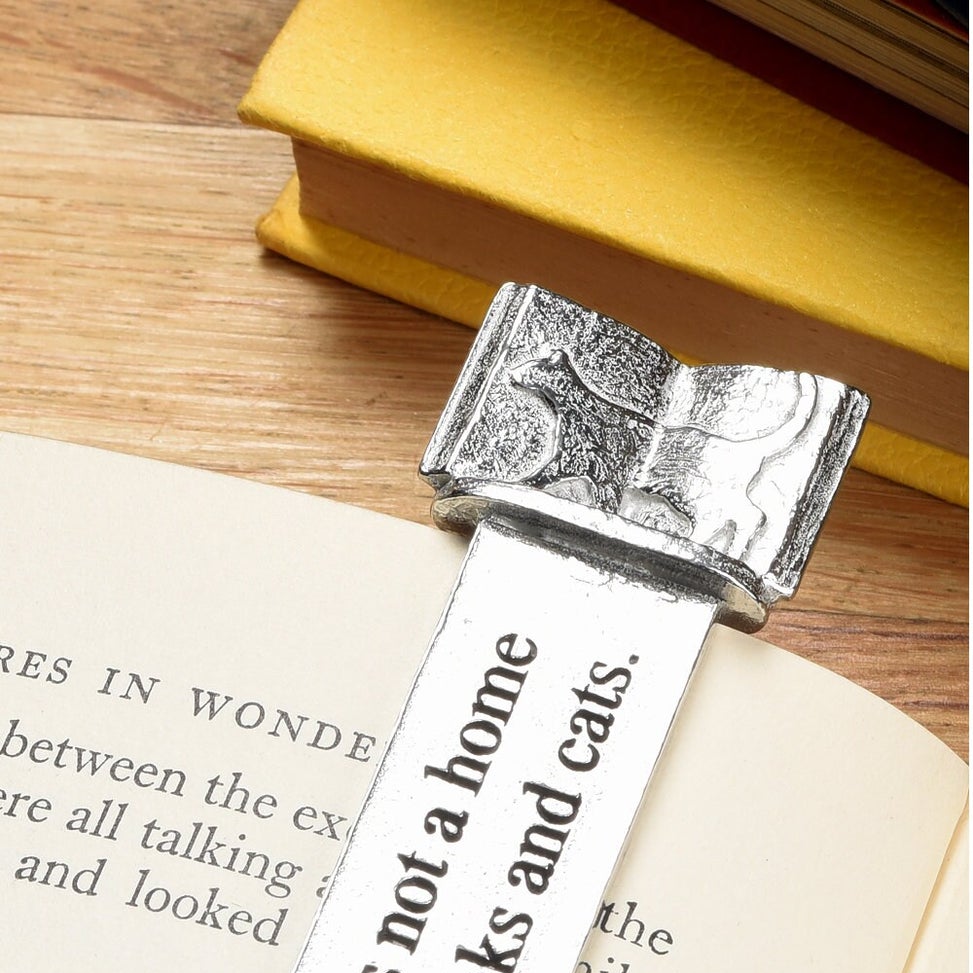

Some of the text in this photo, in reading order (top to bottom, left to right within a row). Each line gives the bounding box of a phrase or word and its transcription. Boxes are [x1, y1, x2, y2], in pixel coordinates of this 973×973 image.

[97, 667, 161, 704] IN
[424, 632, 538, 798] home
[0, 719, 353, 842] between the ex
[424, 806, 471, 844] a
[507, 780, 583, 896] and
[558, 653, 641, 773] cats.
[66, 799, 129, 842] all
[141, 818, 304, 899] talking
[14, 855, 290, 947] and looked
[376, 851, 449, 956] not
